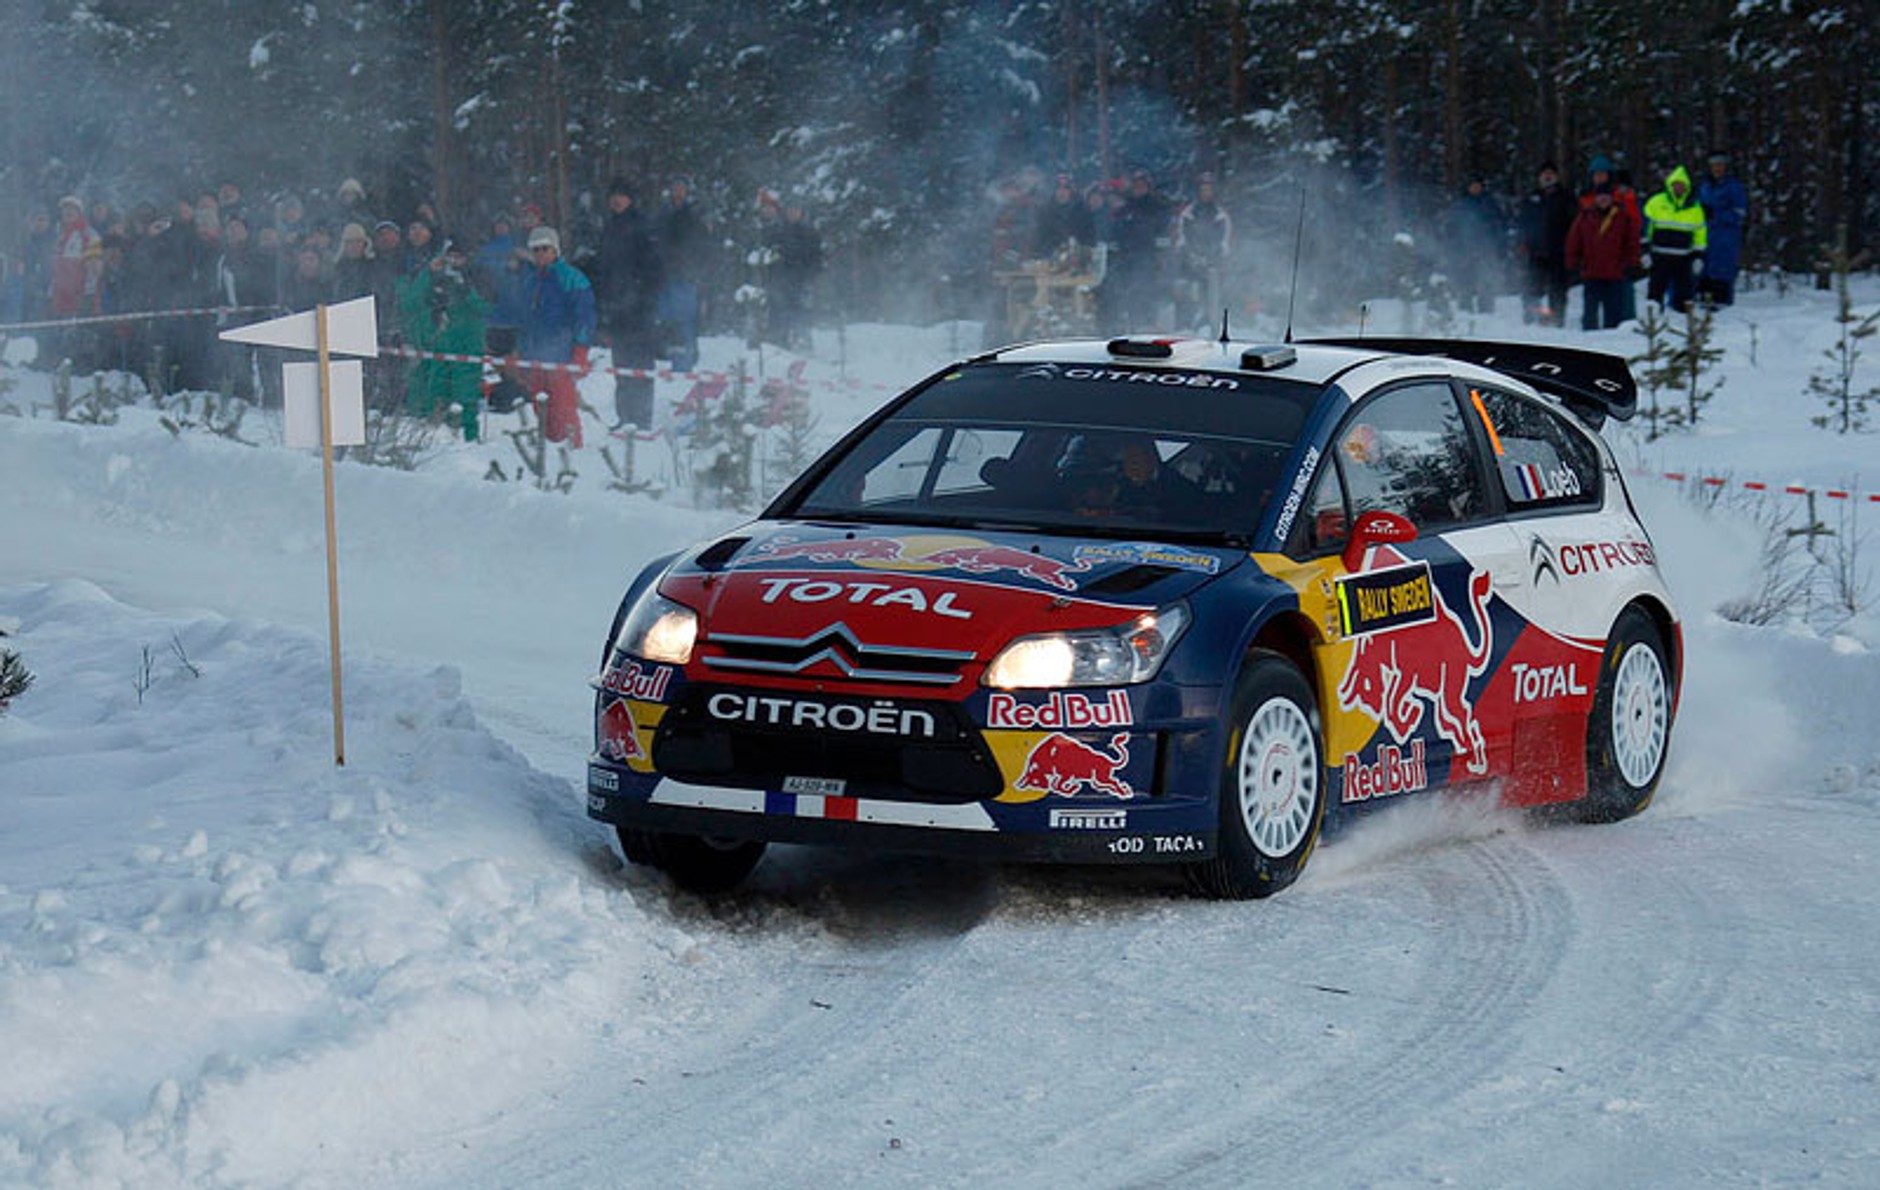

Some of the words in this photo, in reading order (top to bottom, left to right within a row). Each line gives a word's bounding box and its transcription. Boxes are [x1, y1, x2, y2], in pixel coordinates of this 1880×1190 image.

[1538, 461, 1581, 497] Loeb
[760, 577, 972, 619] TOTAL
[1357, 587, 1389, 621] RALLY
[1390, 574, 1431, 615] SWEDEN
[620, 664, 672, 700] Bull
[1511, 662, 1588, 704] TOTAL
[989, 692, 1062, 727] Red
[1066, 690, 1132, 726] Bull
[1343, 744, 1386, 801] Red
[1387, 739, 1427, 792] Bull
[1049, 809, 1127, 829] PIRELLI
